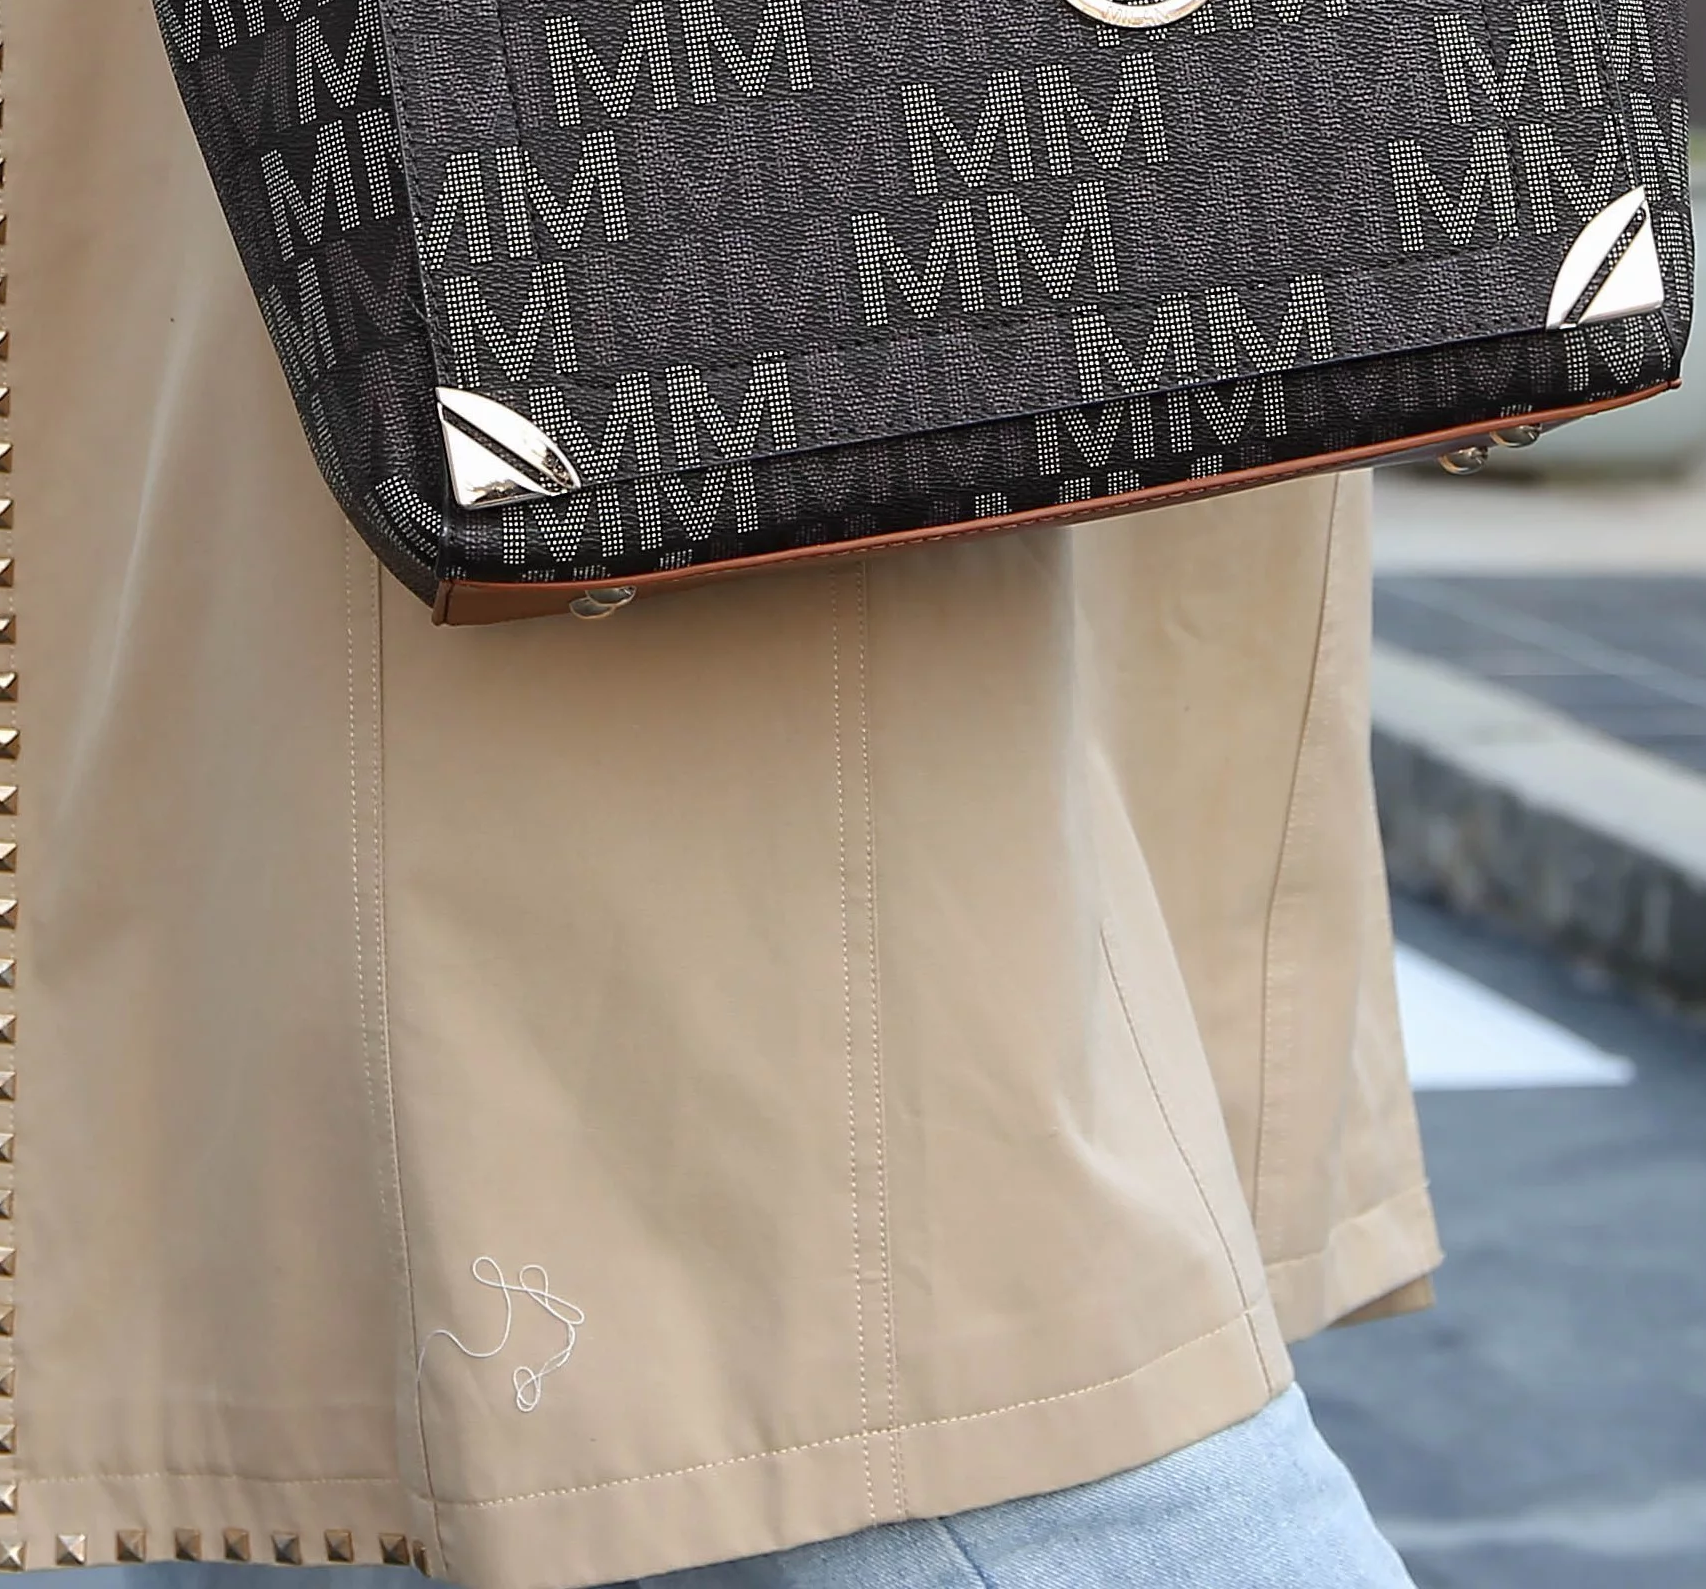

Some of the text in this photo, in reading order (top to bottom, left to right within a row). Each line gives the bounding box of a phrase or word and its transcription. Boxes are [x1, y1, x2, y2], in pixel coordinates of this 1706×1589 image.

[901, 52, 1173, 195] MM
[852, 181, 1119, 326] MM
[1071, 275, 1333, 403] MM
